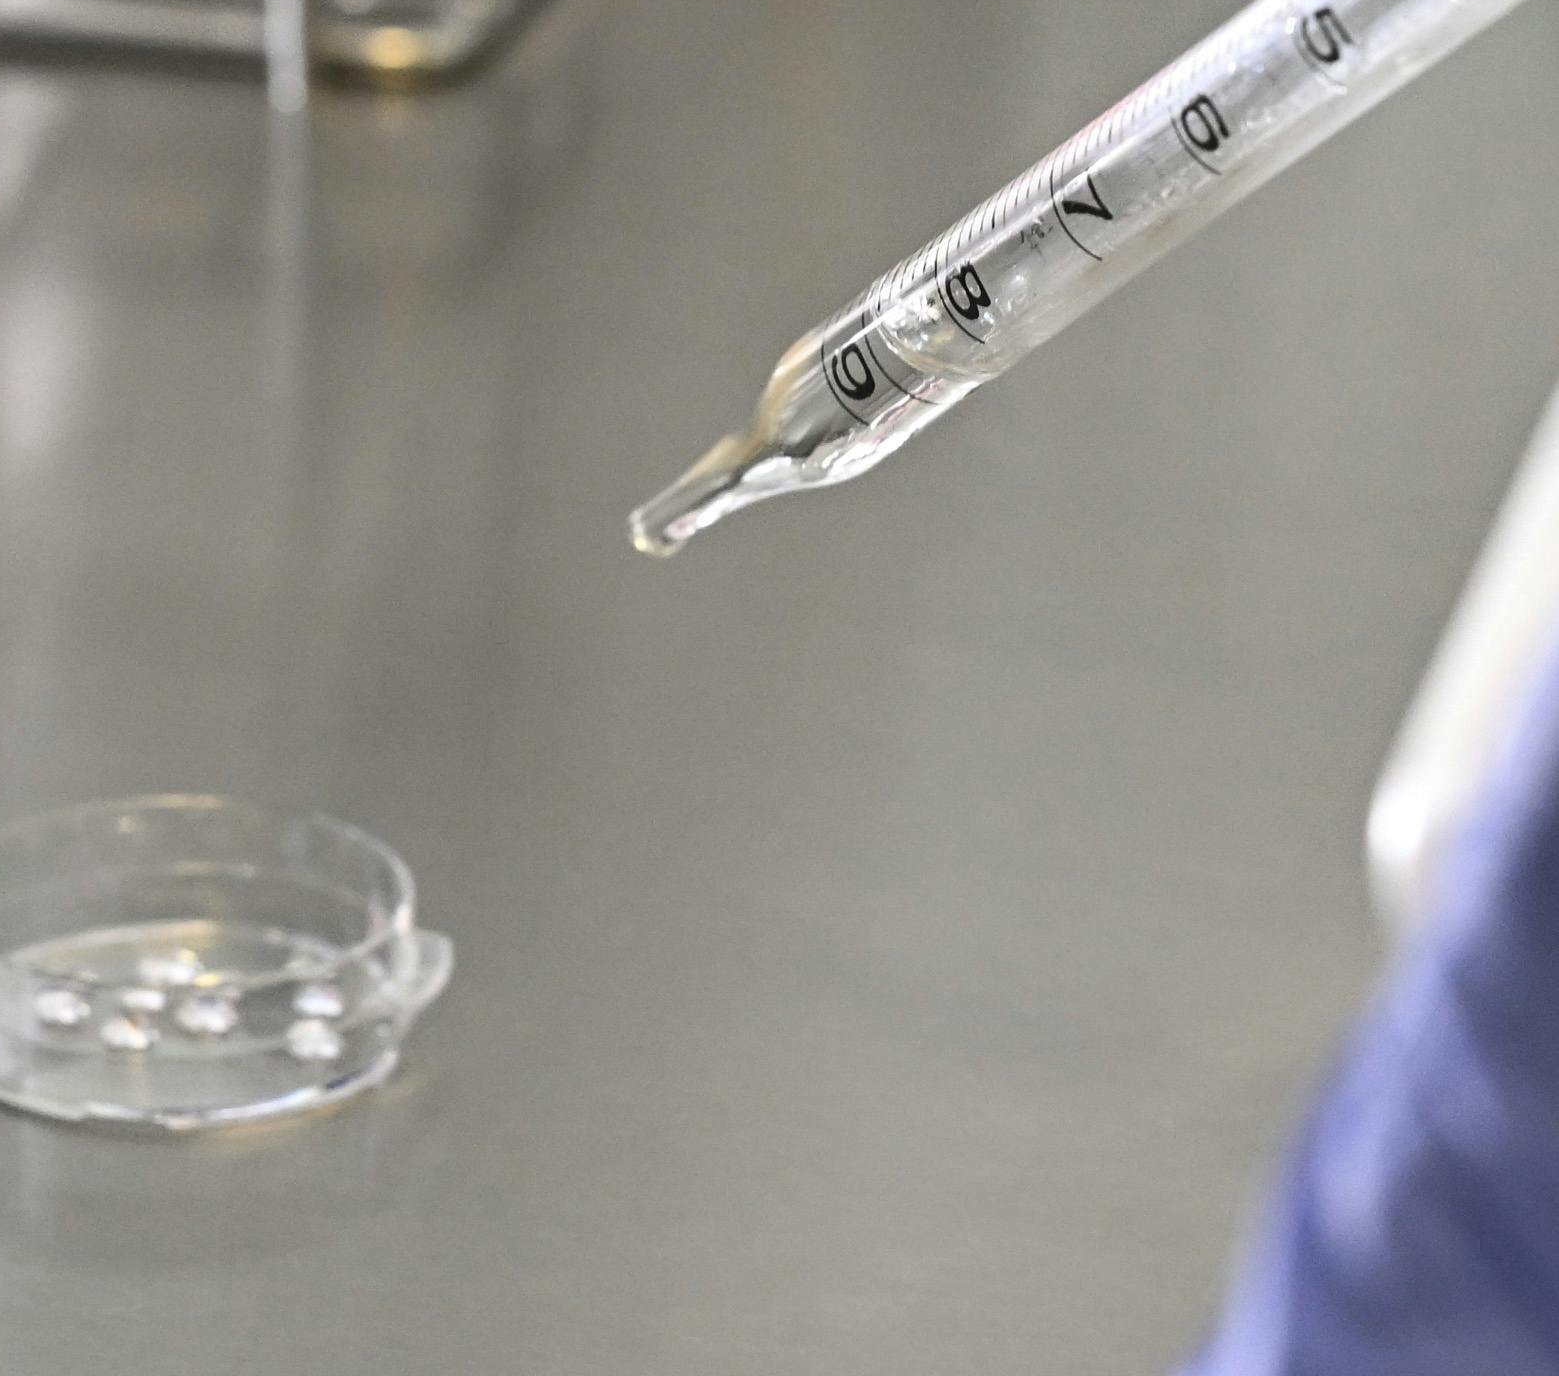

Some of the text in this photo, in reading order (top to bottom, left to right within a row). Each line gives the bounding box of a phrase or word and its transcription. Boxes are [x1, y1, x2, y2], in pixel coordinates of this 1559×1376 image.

[1302, 7, 1354, 64] 5
[1180, 94, 1230, 153] 6
[1061, 173, 1114, 221] 7
[944, 261, 992, 321] 8
[831, 342, 876, 401] 9
